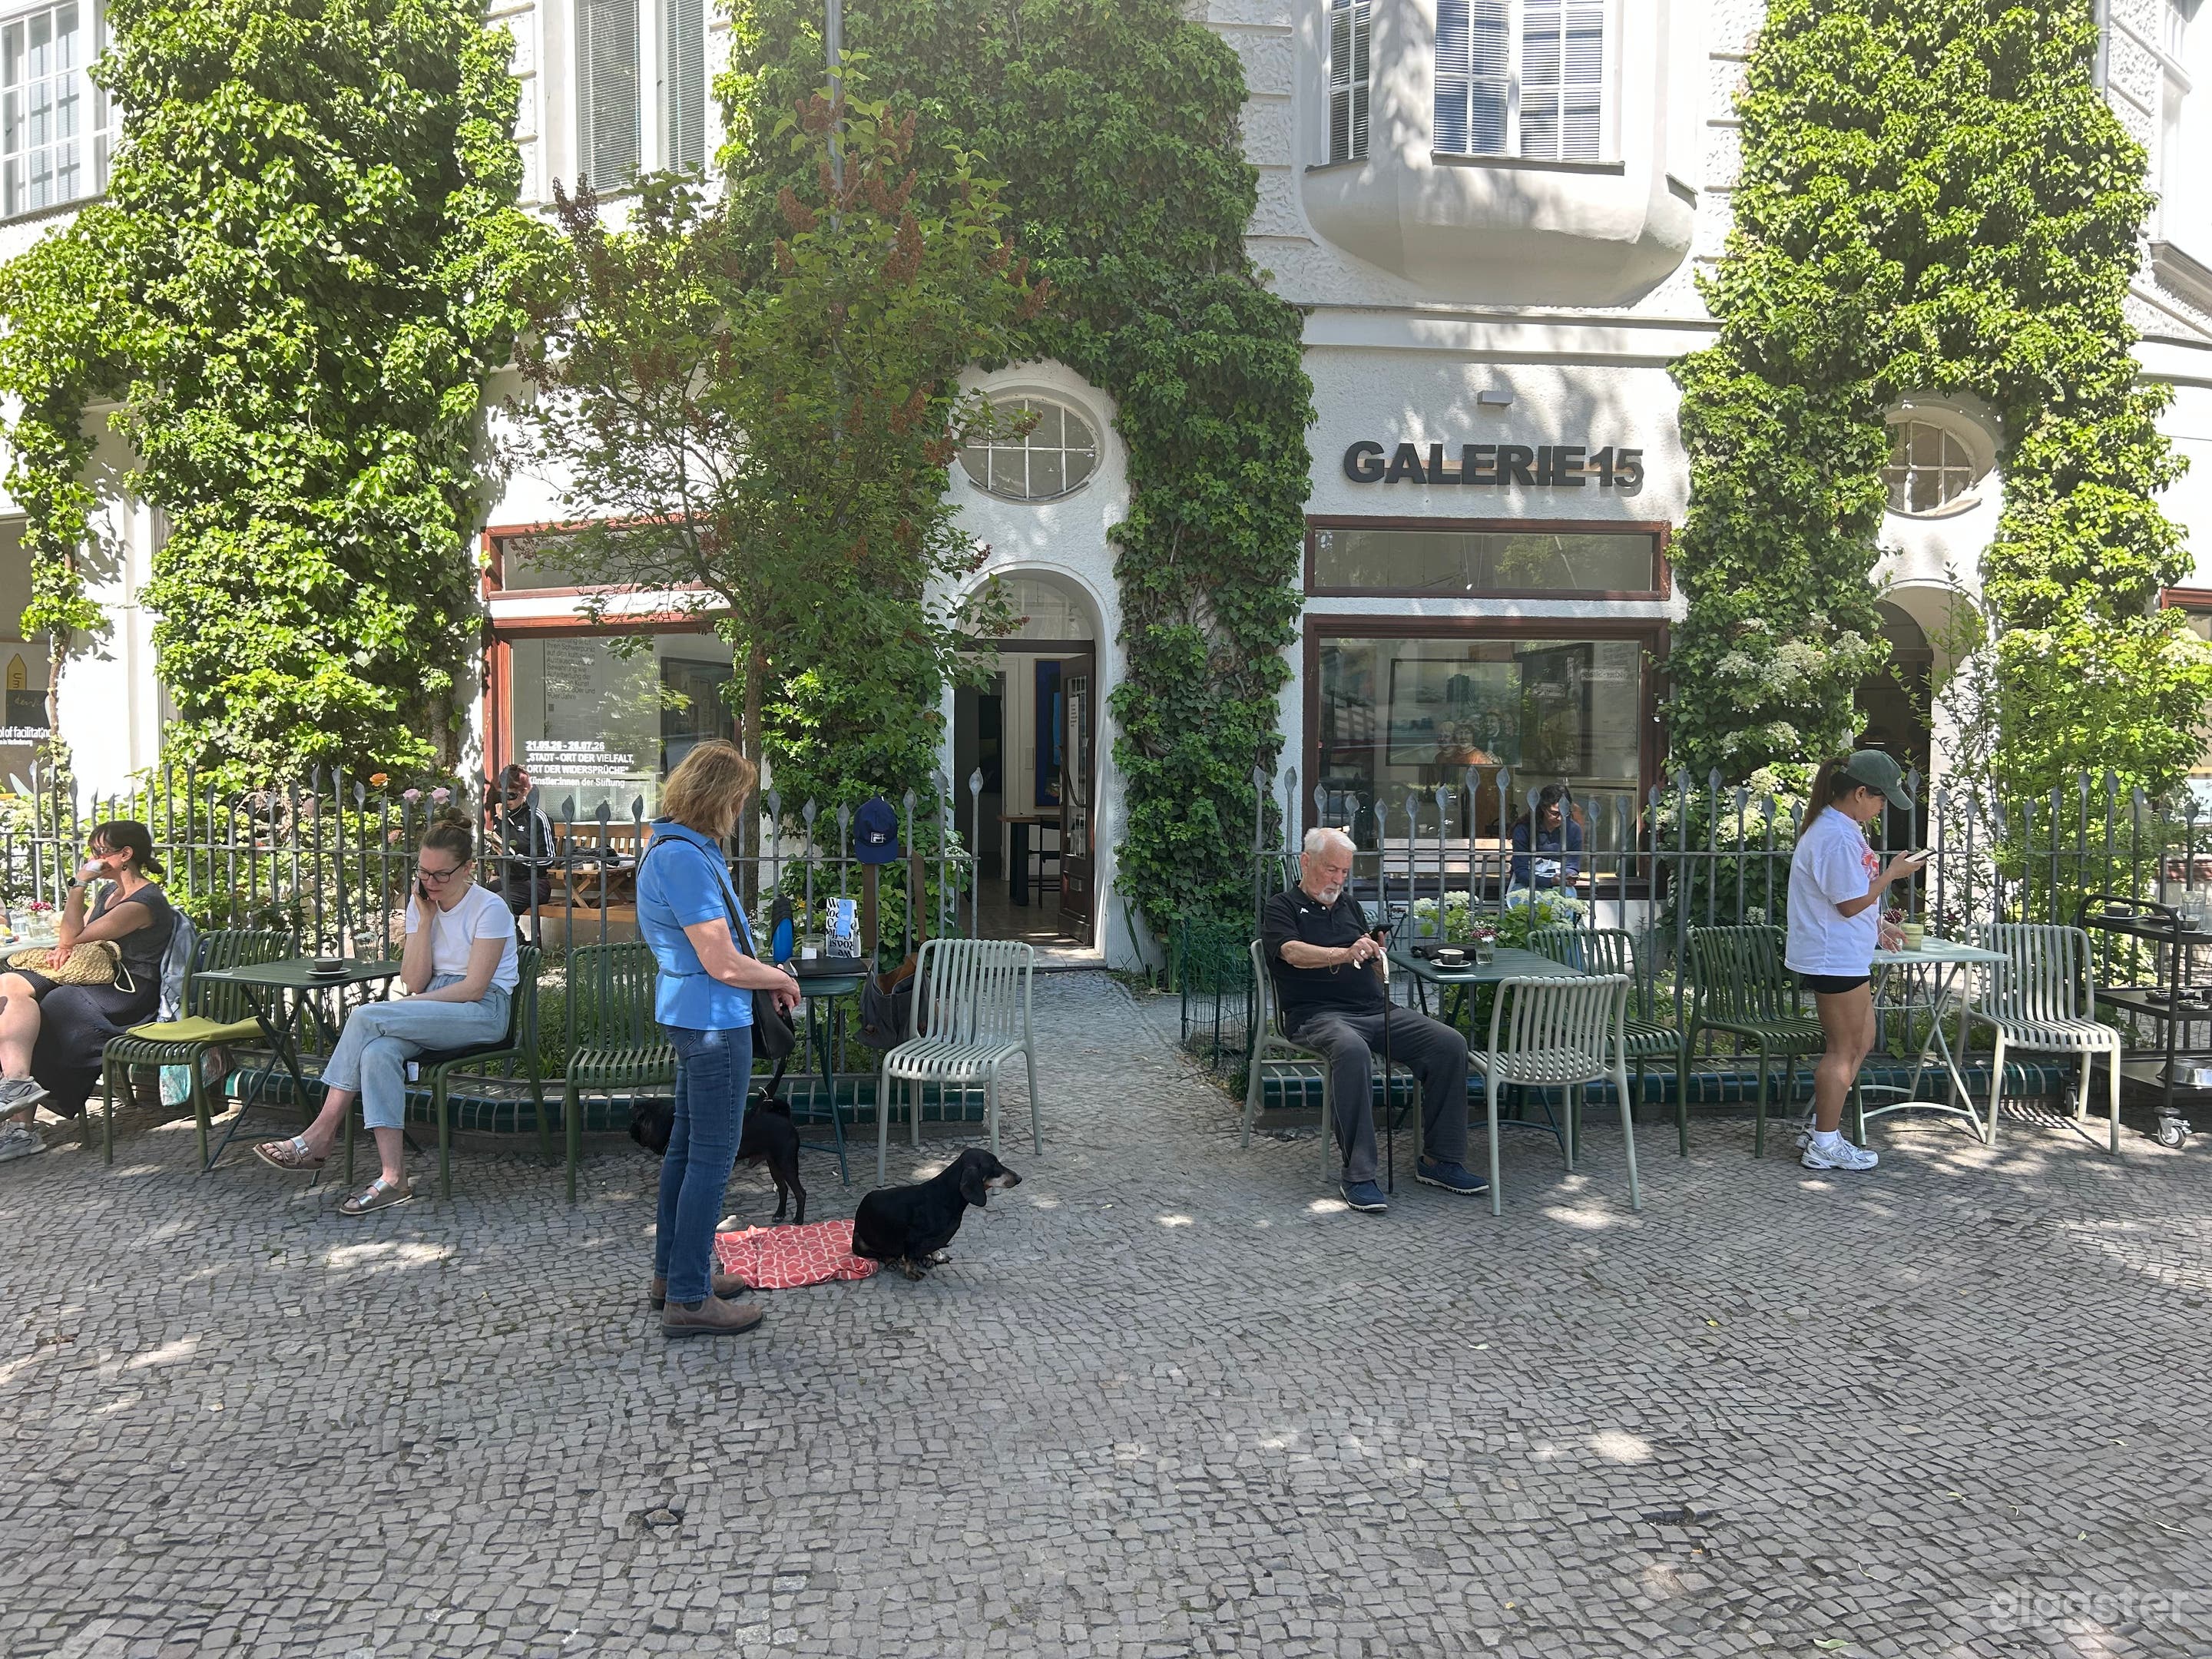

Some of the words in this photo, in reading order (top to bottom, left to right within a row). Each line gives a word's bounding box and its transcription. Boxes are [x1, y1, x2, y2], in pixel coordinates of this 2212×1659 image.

[5, 726, 13, 738] of
[560, 753, 577, 763] ORT
[578, 753, 595, 763] DER
[596, 753, 634, 764] VIELFALT,
[527, 764, 544, 773] ORT
[545, 764, 562, 773] DER
[581, 777, 594, 786] der
[595, 777, 625, 789] Stiftung
[830, 939, 855, 951] Roast
[838, 949, 853, 959] We
